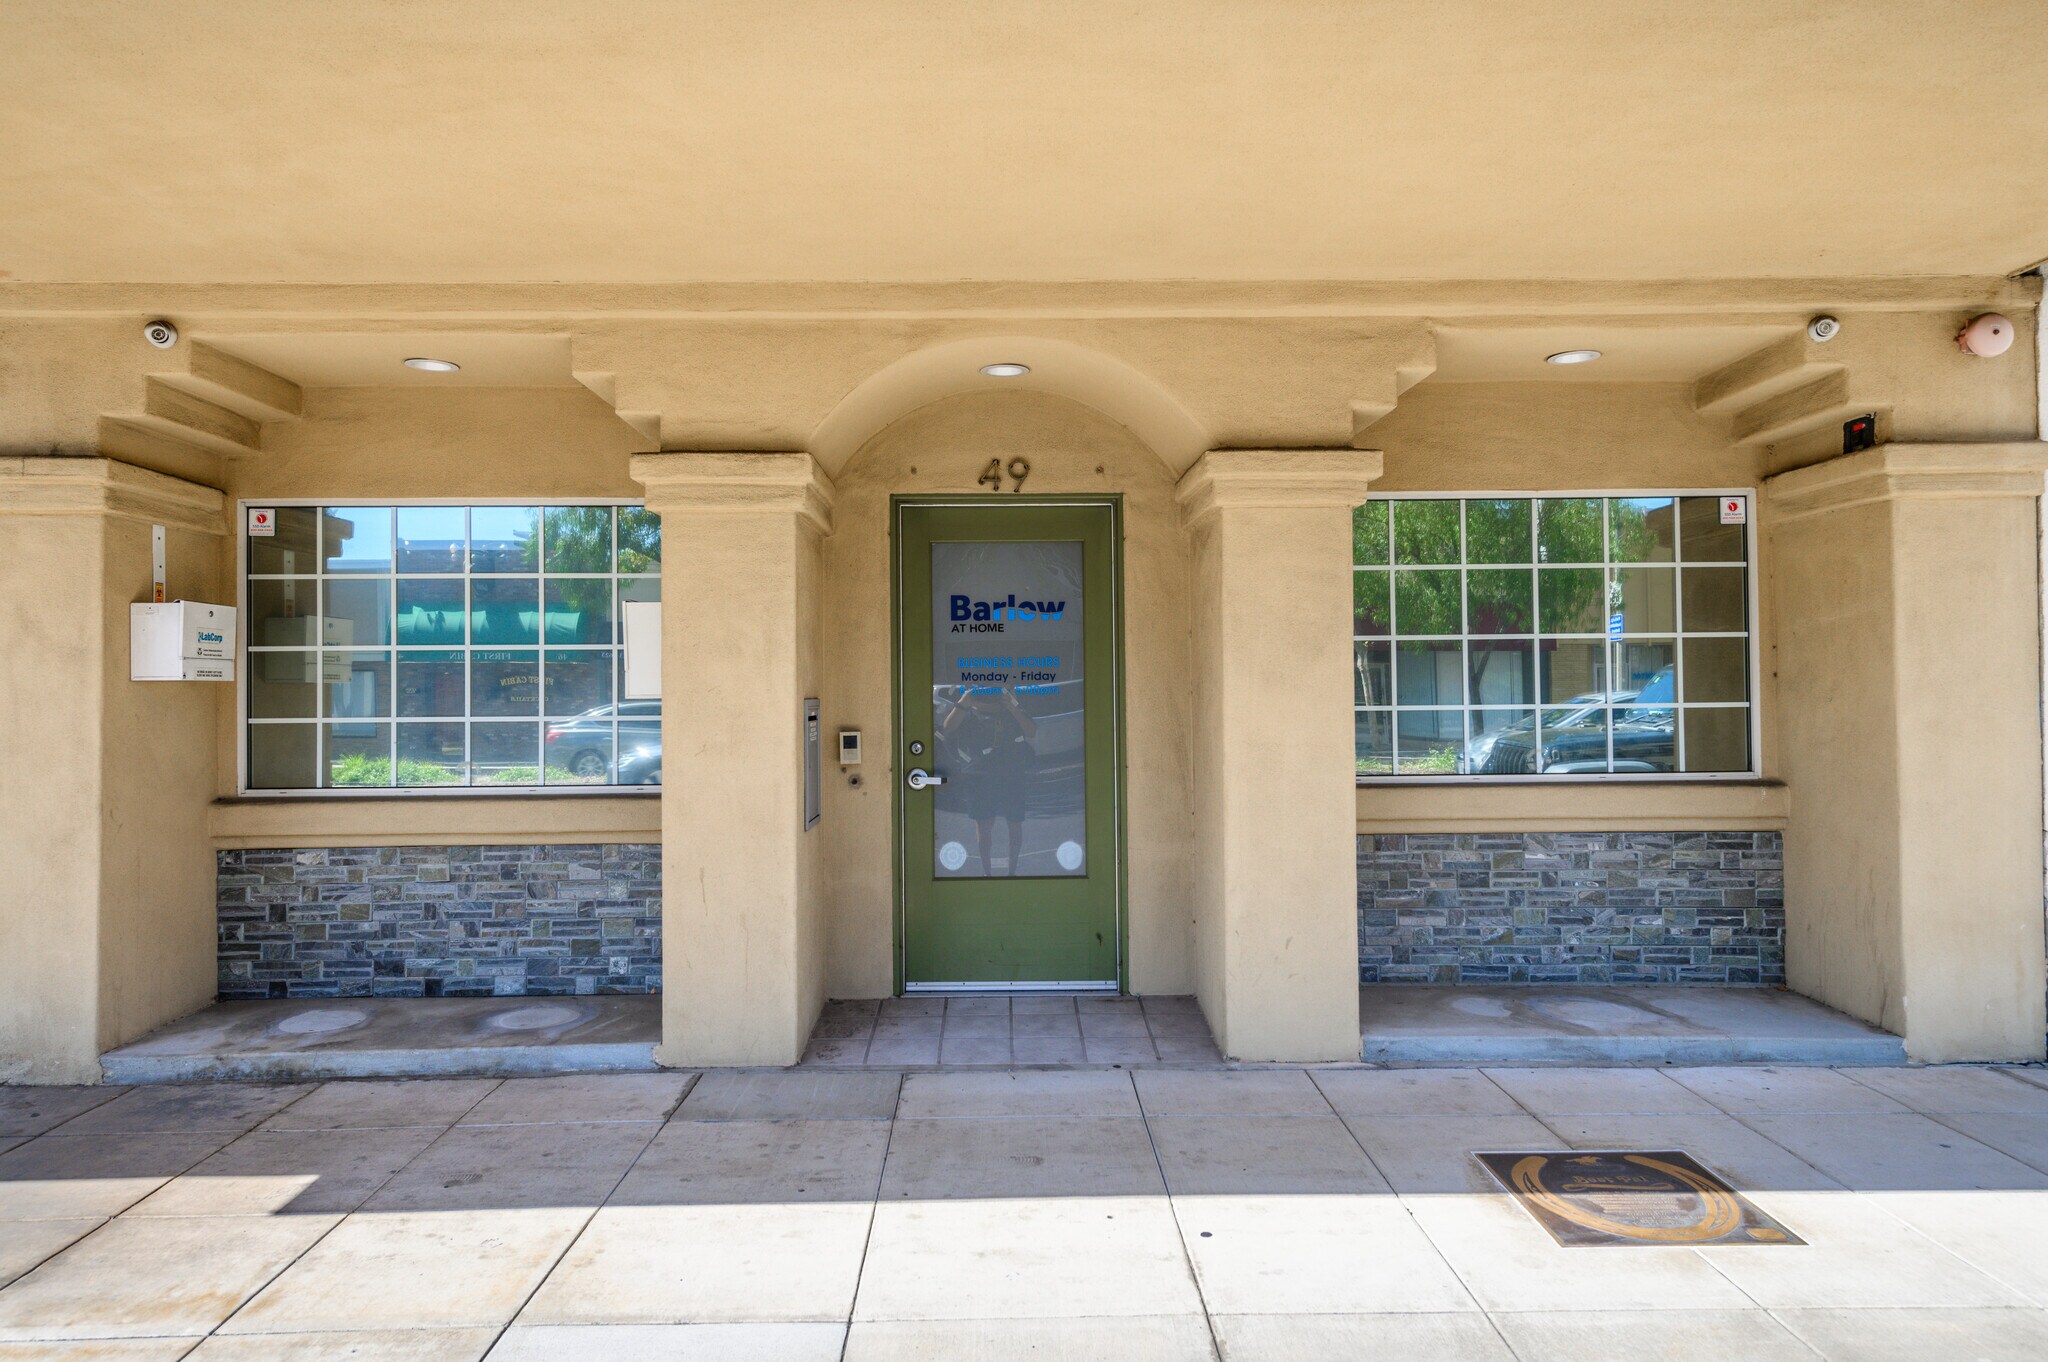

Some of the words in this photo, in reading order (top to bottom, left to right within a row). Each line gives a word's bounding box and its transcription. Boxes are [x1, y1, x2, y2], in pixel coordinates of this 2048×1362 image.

[978, 457, 1030, 492] 49
[950, 594, 1065, 621] Barlow
[951, 623, 966, 632] AT
[970, 623, 1004, 632] HOME
[201, 632, 223, 643] LabCorp
[957, 657, 1013, 669] BUSINESS
[1017, 656, 1060, 668] HOURS
[961, 672, 1009, 683] Monday
[1021, 671, 1057, 682] Friday
